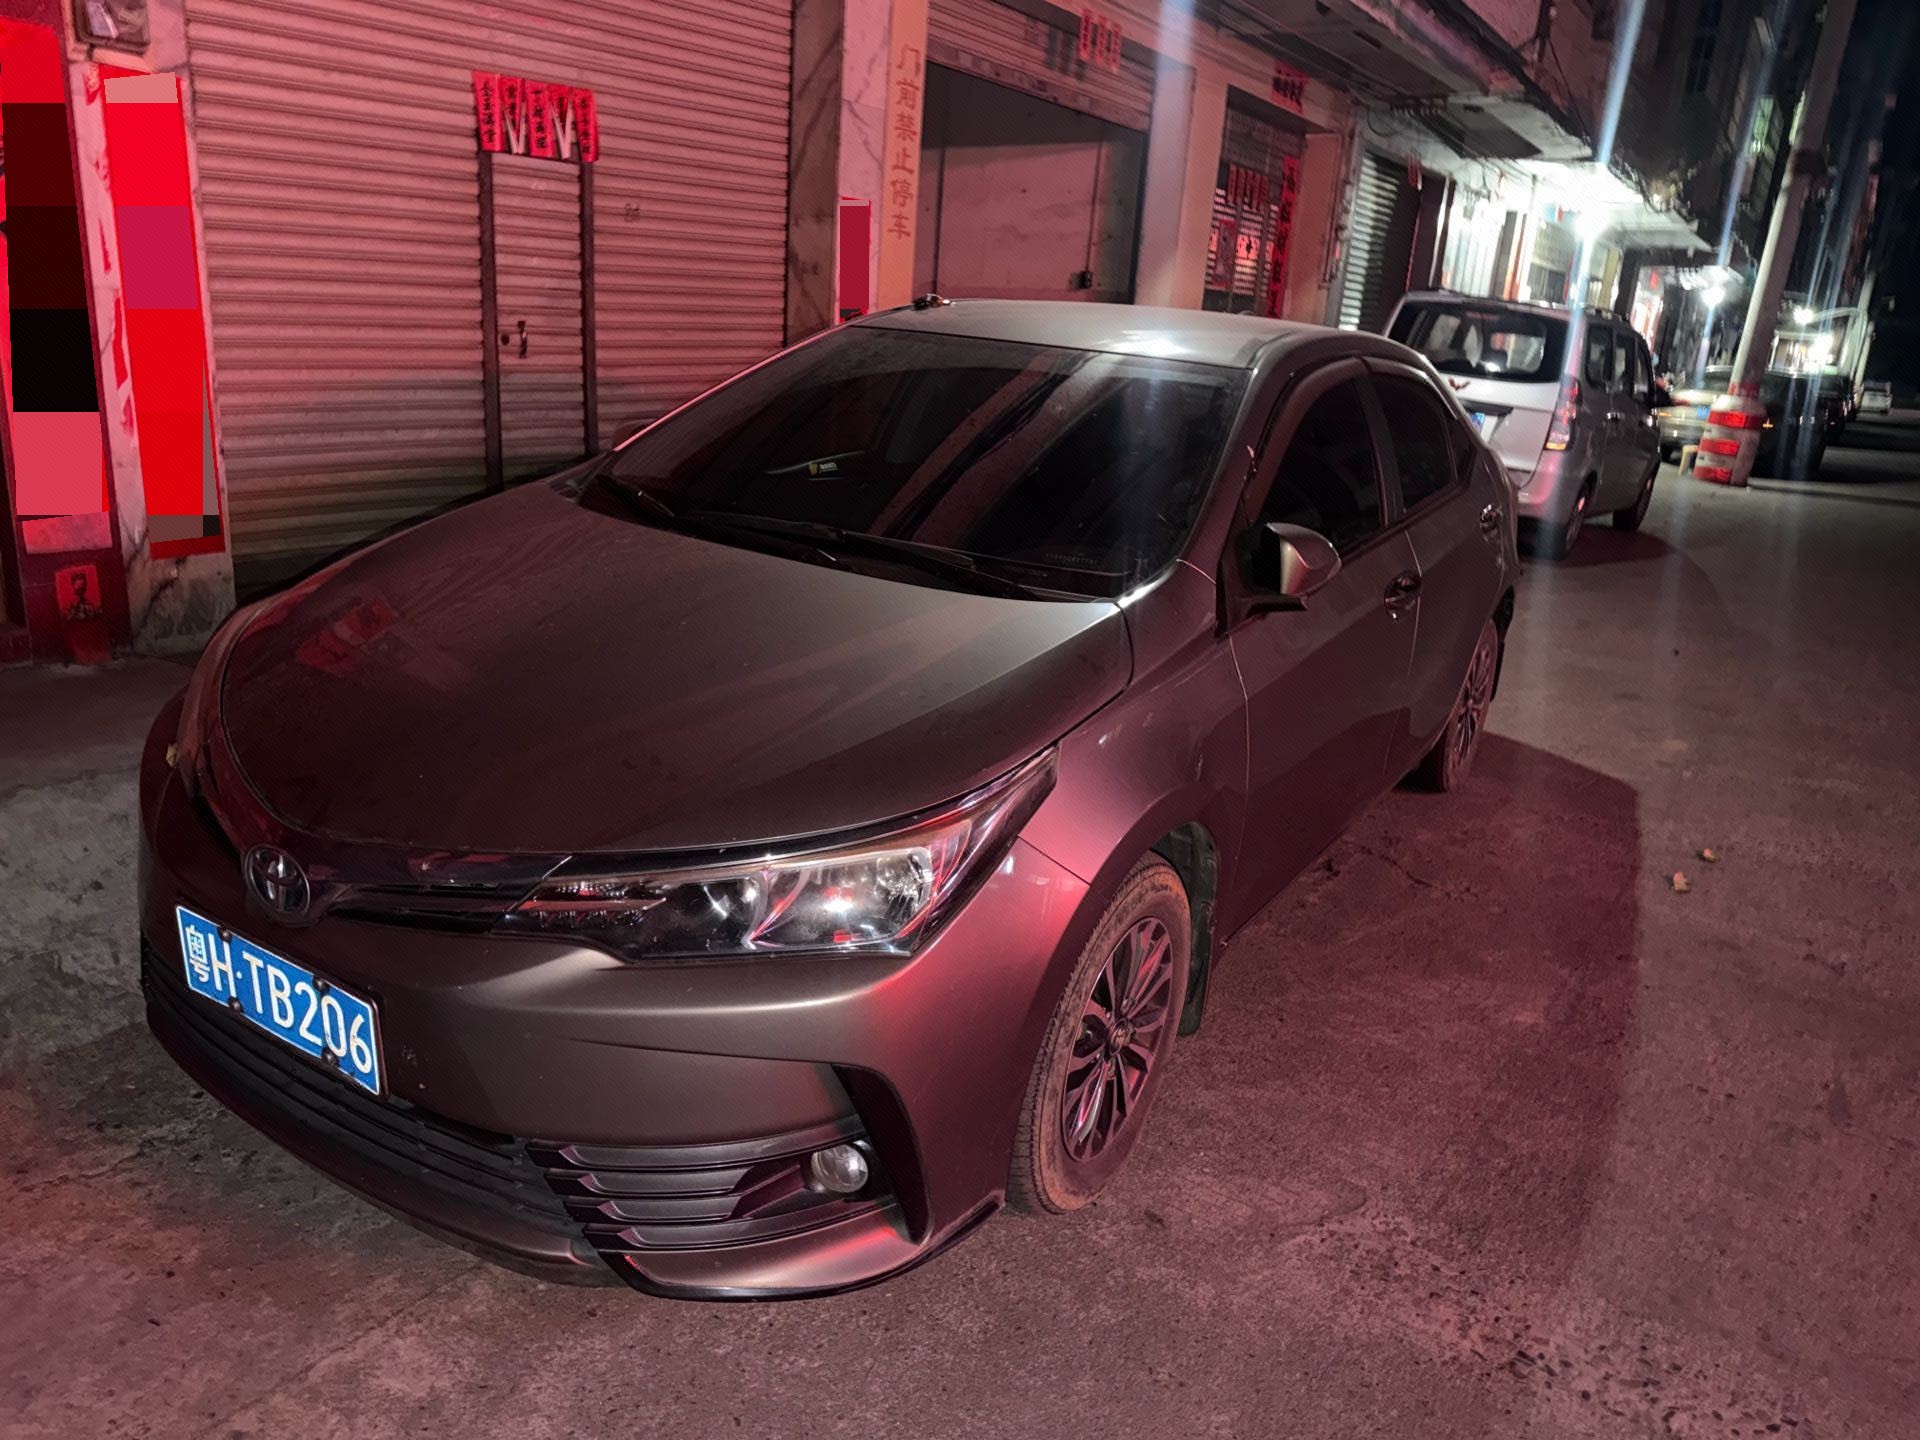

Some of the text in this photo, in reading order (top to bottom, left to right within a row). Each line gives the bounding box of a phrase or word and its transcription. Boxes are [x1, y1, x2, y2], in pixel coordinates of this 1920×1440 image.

[887, 44, 922, 241] 门前禁止停车
